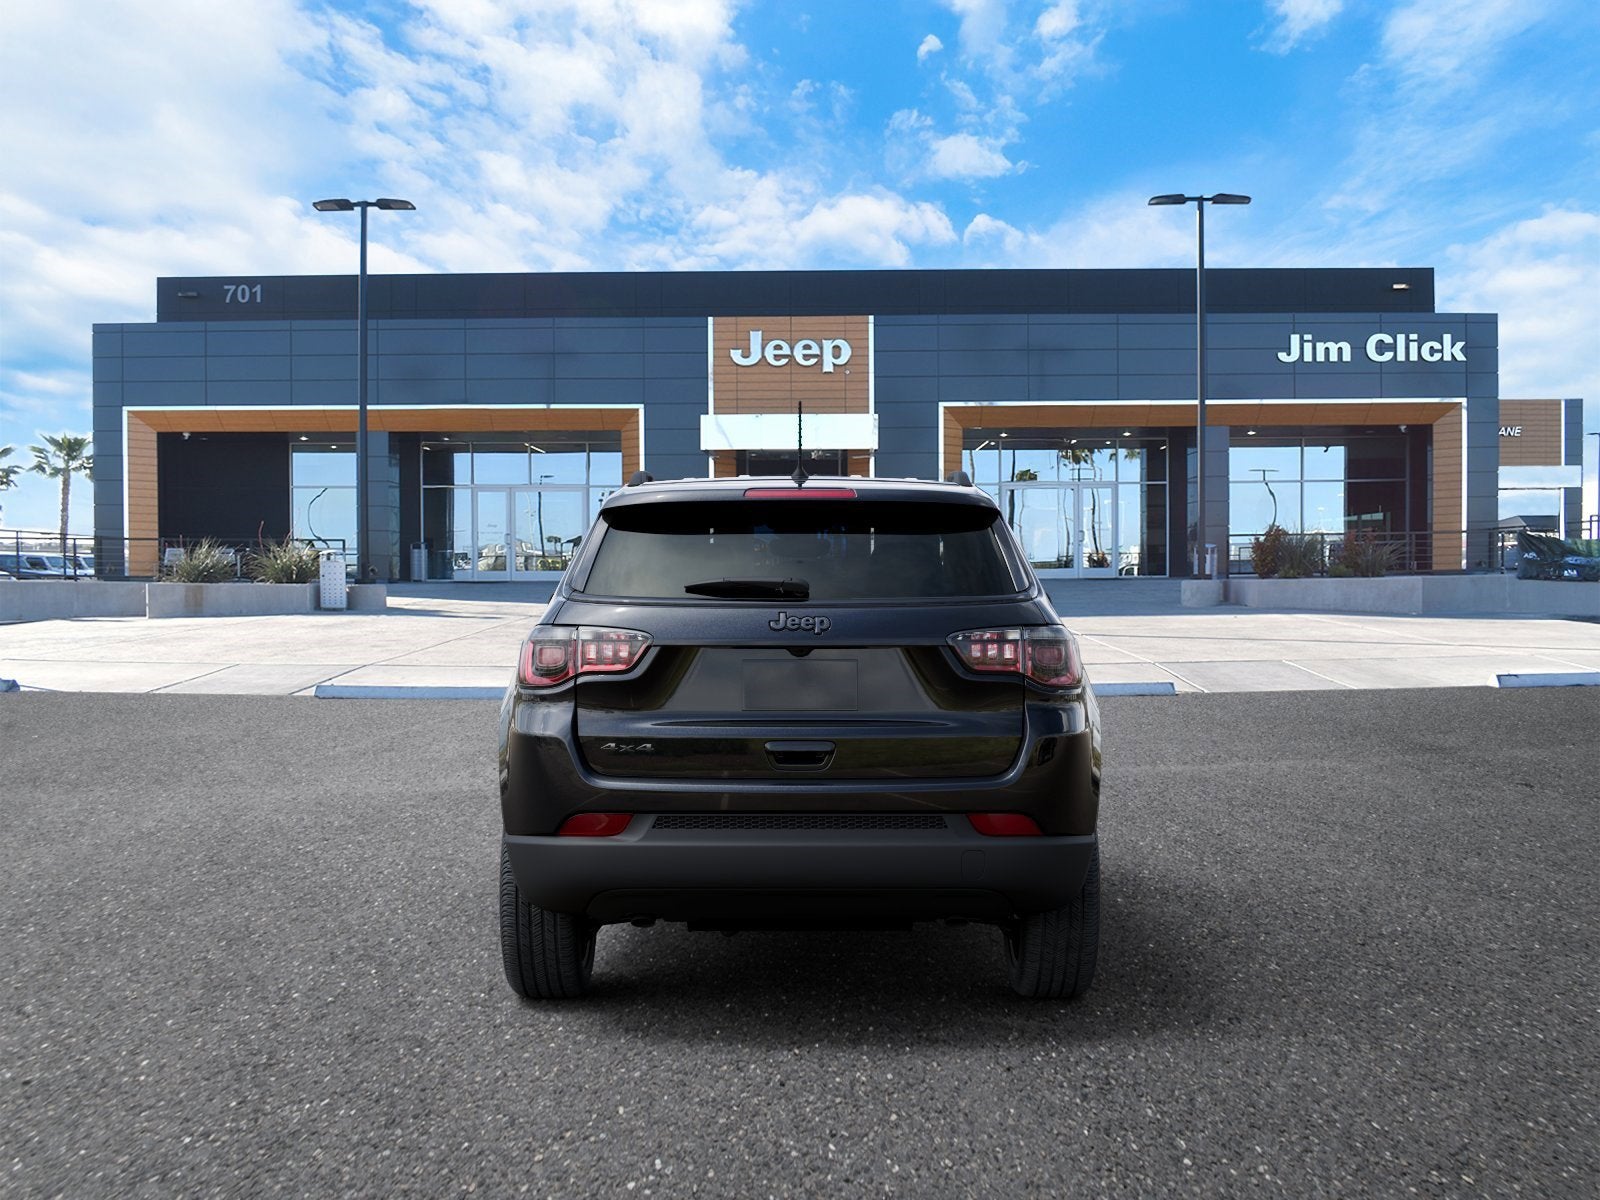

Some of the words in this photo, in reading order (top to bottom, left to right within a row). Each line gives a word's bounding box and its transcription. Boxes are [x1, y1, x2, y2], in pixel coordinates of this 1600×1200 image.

[223, 284, 262, 304] 701
[729, 330, 852, 374] Jeep
[1277, 333, 1352, 363] Jim
[1365, 333, 1467, 362] Click
[1498, 426, 1522, 437] ANE
[768, 611, 831, 635] Jeep
